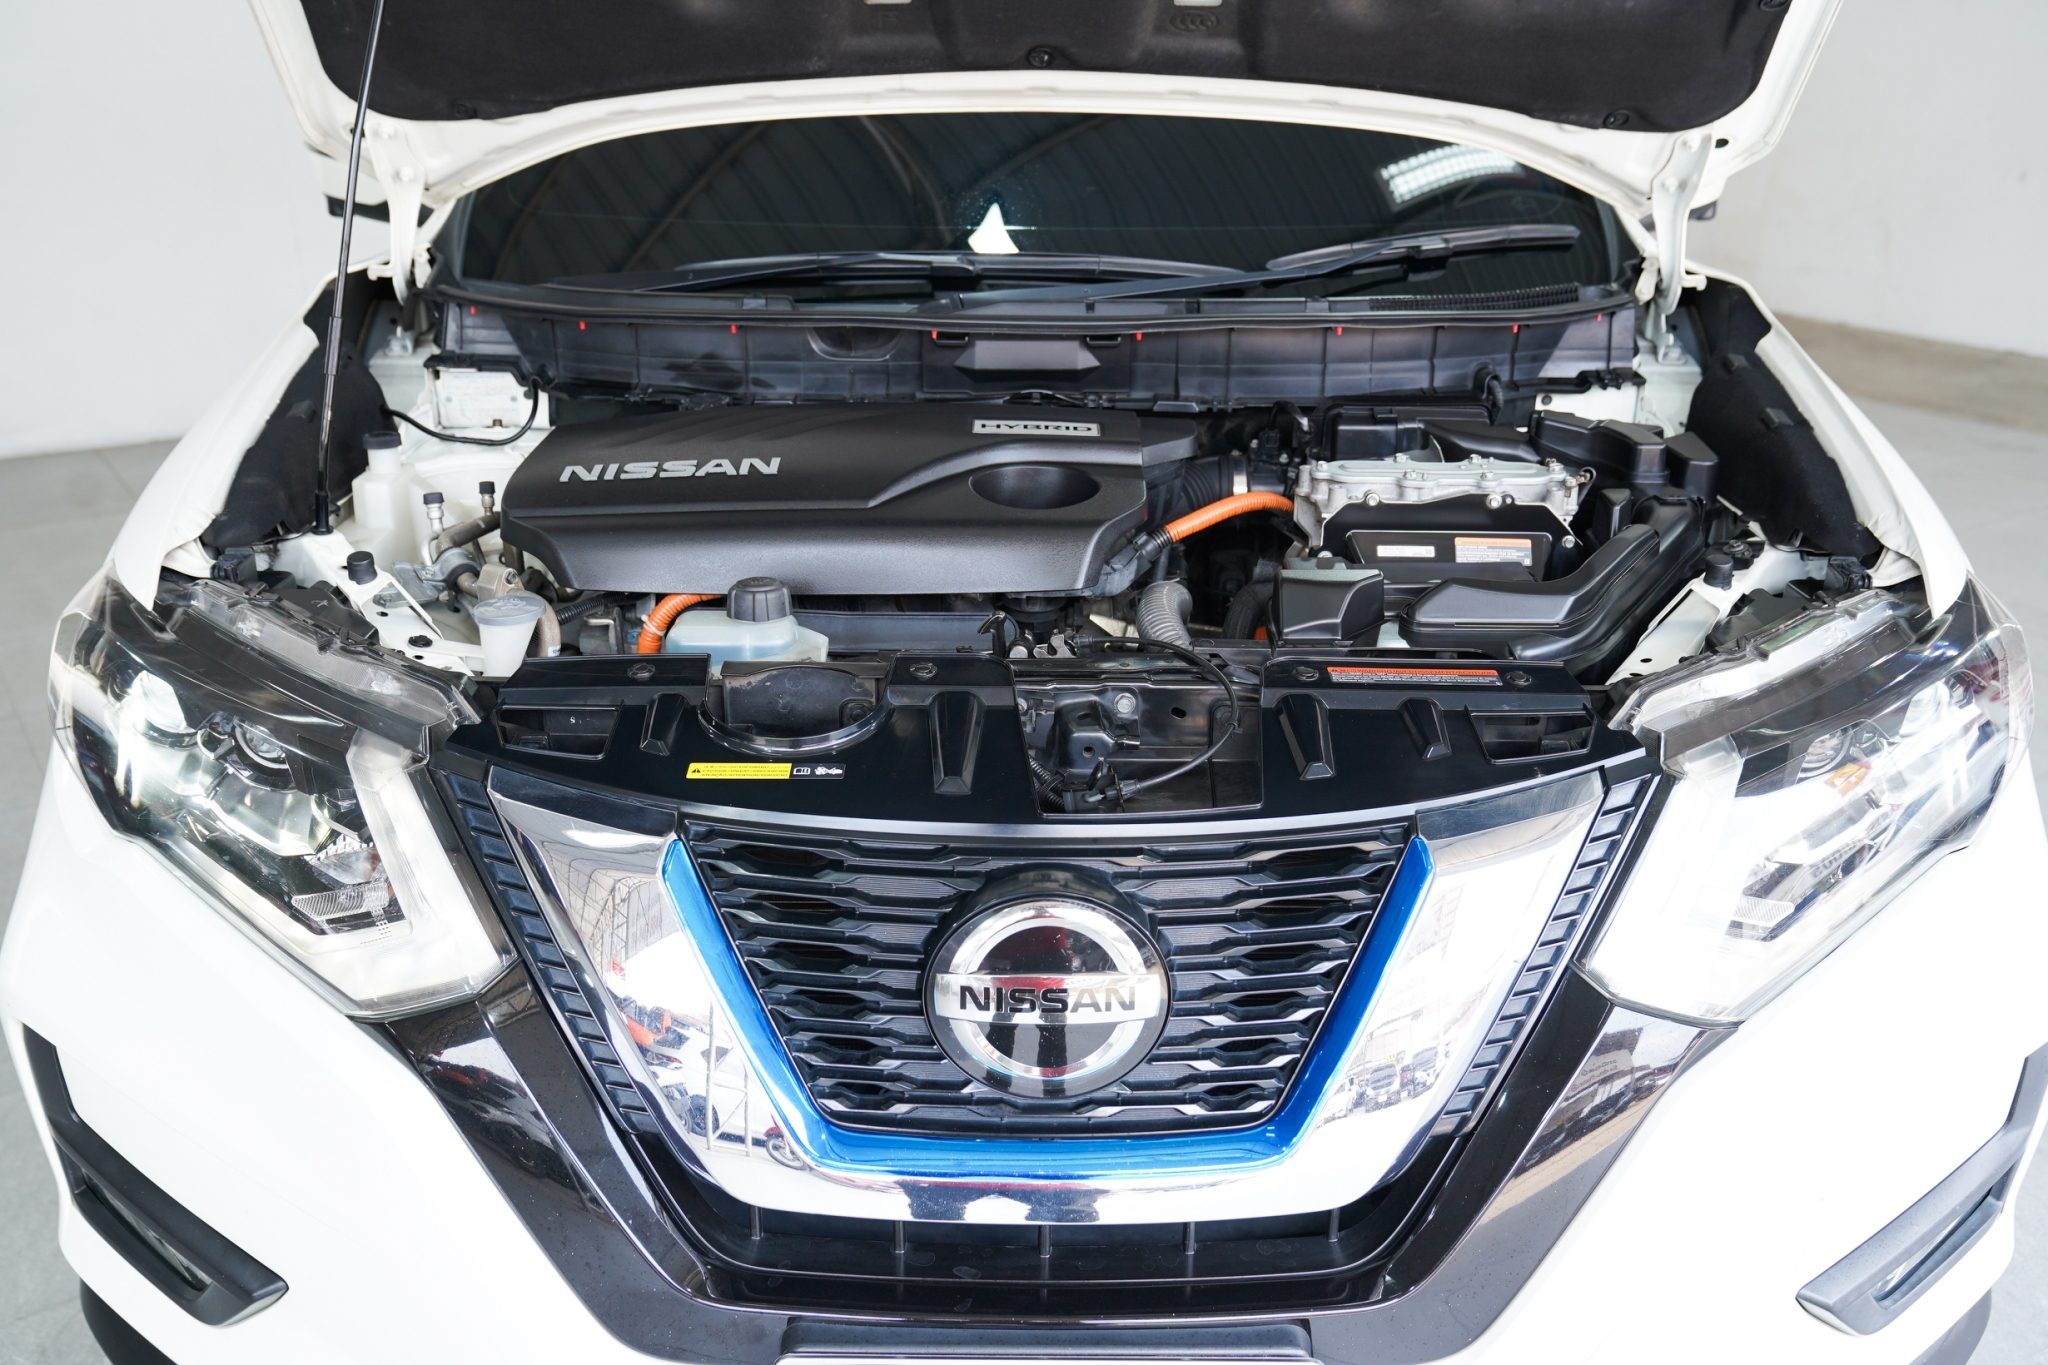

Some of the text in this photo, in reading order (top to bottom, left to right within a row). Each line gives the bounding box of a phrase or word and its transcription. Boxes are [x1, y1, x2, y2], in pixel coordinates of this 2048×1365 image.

[981, 423, 1092, 431] HYBRID
[559, 457, 781, 482] NISSAN
[959, 985, 1135, 1013] NISSAN
